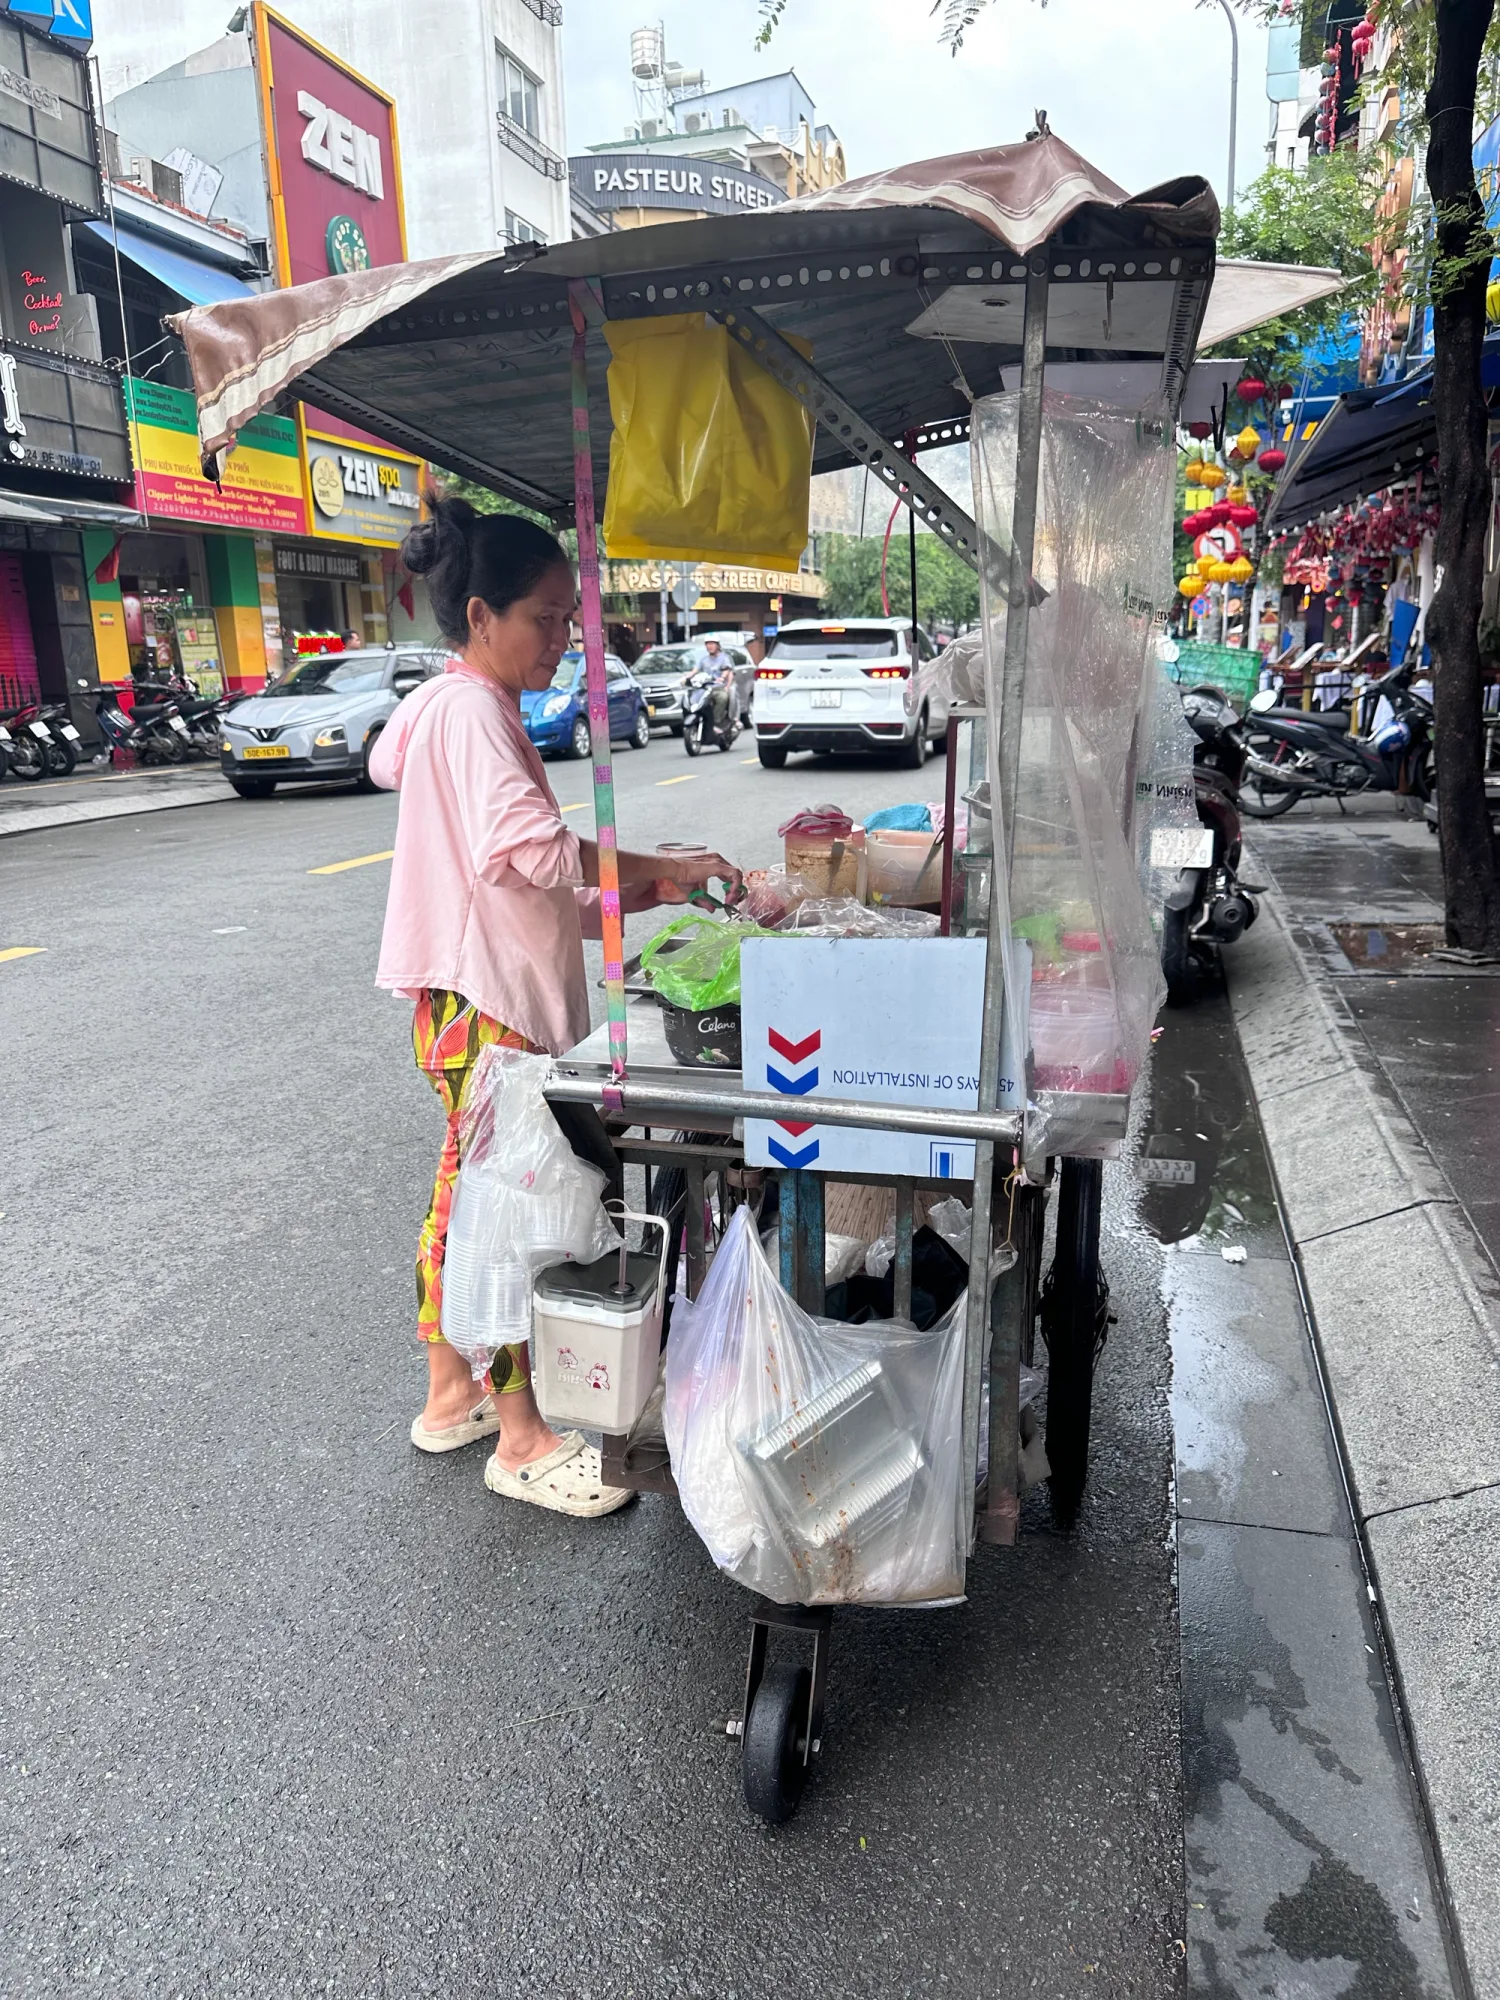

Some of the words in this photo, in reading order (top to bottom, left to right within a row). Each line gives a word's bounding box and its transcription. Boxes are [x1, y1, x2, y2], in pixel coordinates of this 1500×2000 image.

[297, 90, 384, 200] ZEN
[593, 168, 704, 196] PASTEUR
[710, 175, 775, 208] STREET
[24, 292, 63, 310] Cocktail
[341, 455, 380, 498] ZEN
[378, 465, 401, 493] spa
[175, 481, 193, 492] Glass
[147, 489, 173, 503] Clipper
[174, 493, 199, 505] Lighter
[277, 551, 297, 570] FOOT
[306, 554, 325, 574] BODY
[326, 556, 359, 577] MASSAGE
[832, 1070, 930, 1088] INSTALLATION
[934, 1075, 953, 1089] OF
[957, 1076, 980, 1090] AYS
[999, 1078, 1015, 1092] 45
